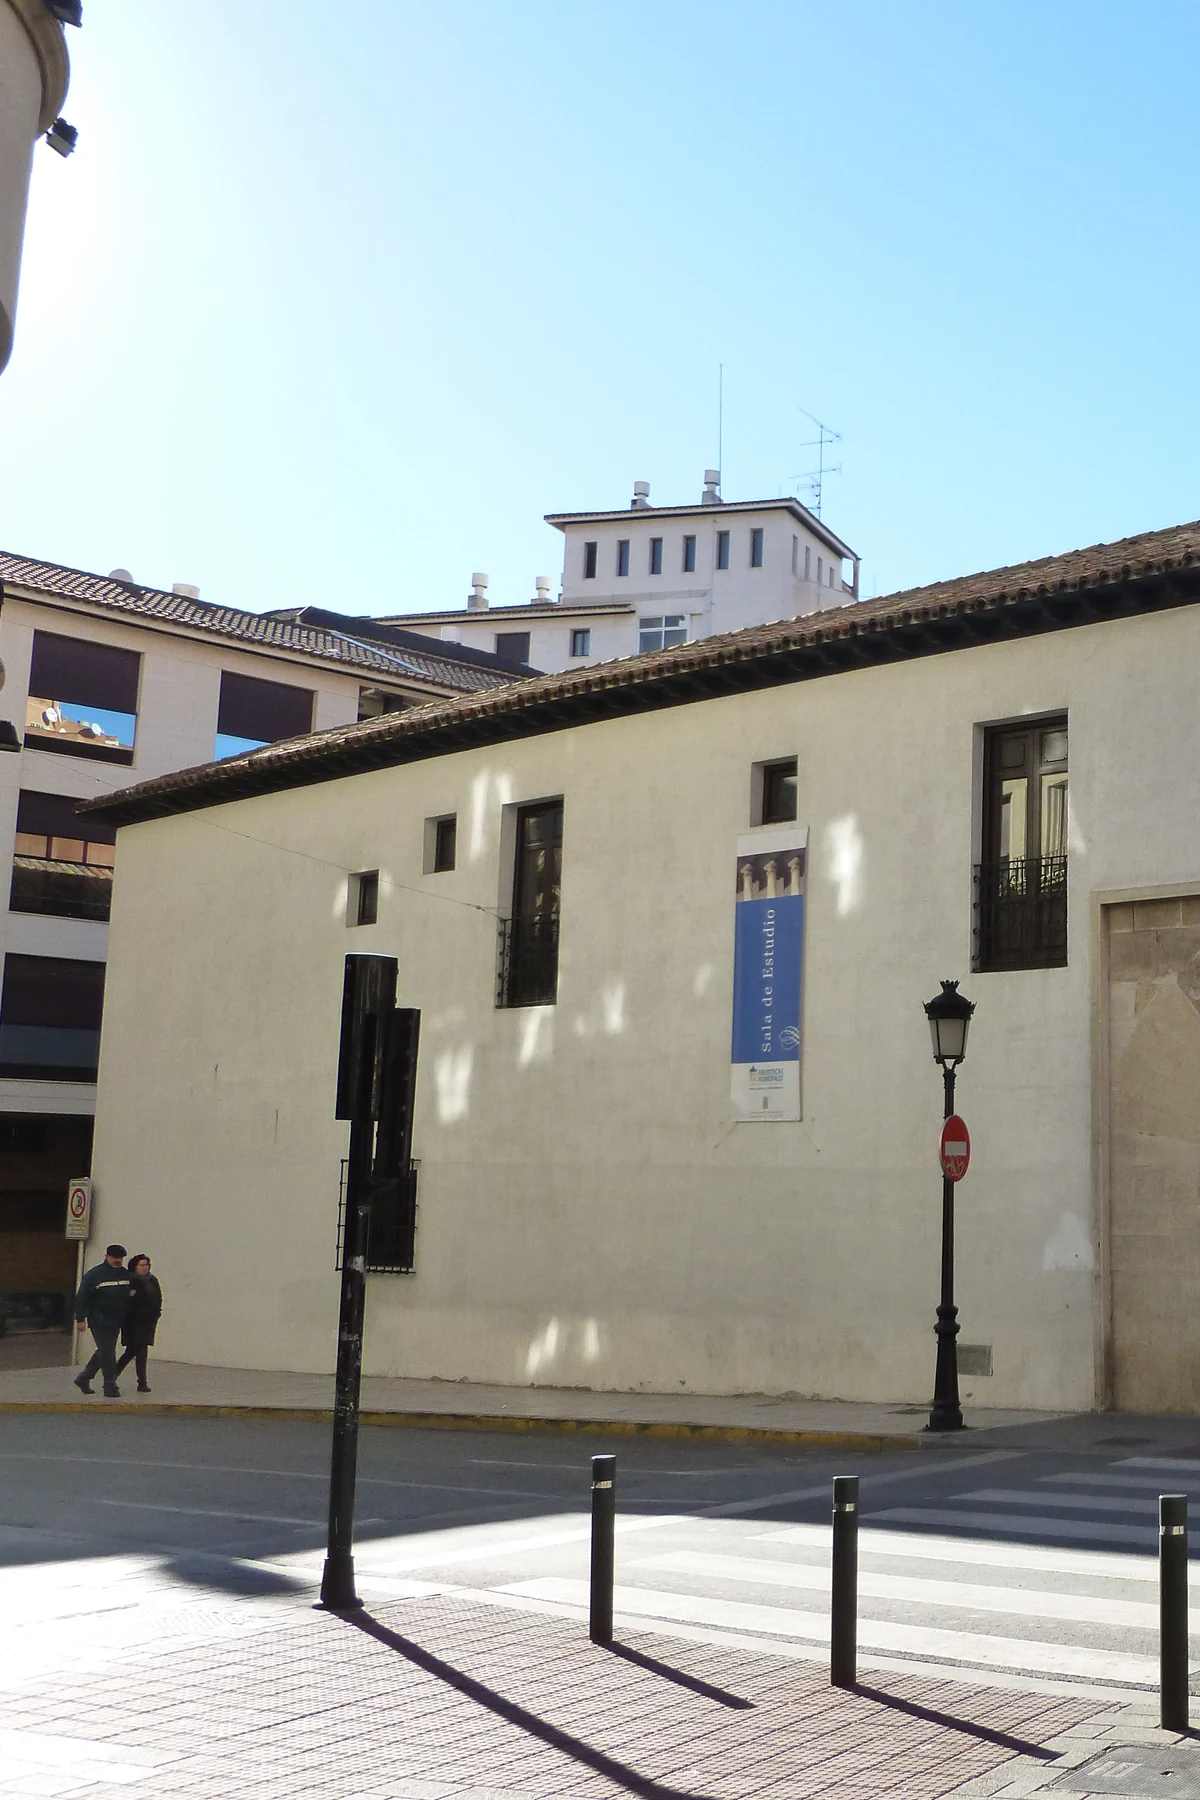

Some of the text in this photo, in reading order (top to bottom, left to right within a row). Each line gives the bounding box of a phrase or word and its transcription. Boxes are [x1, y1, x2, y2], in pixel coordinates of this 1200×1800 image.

[762, 909, 776, 1053] Sala de Estudio
